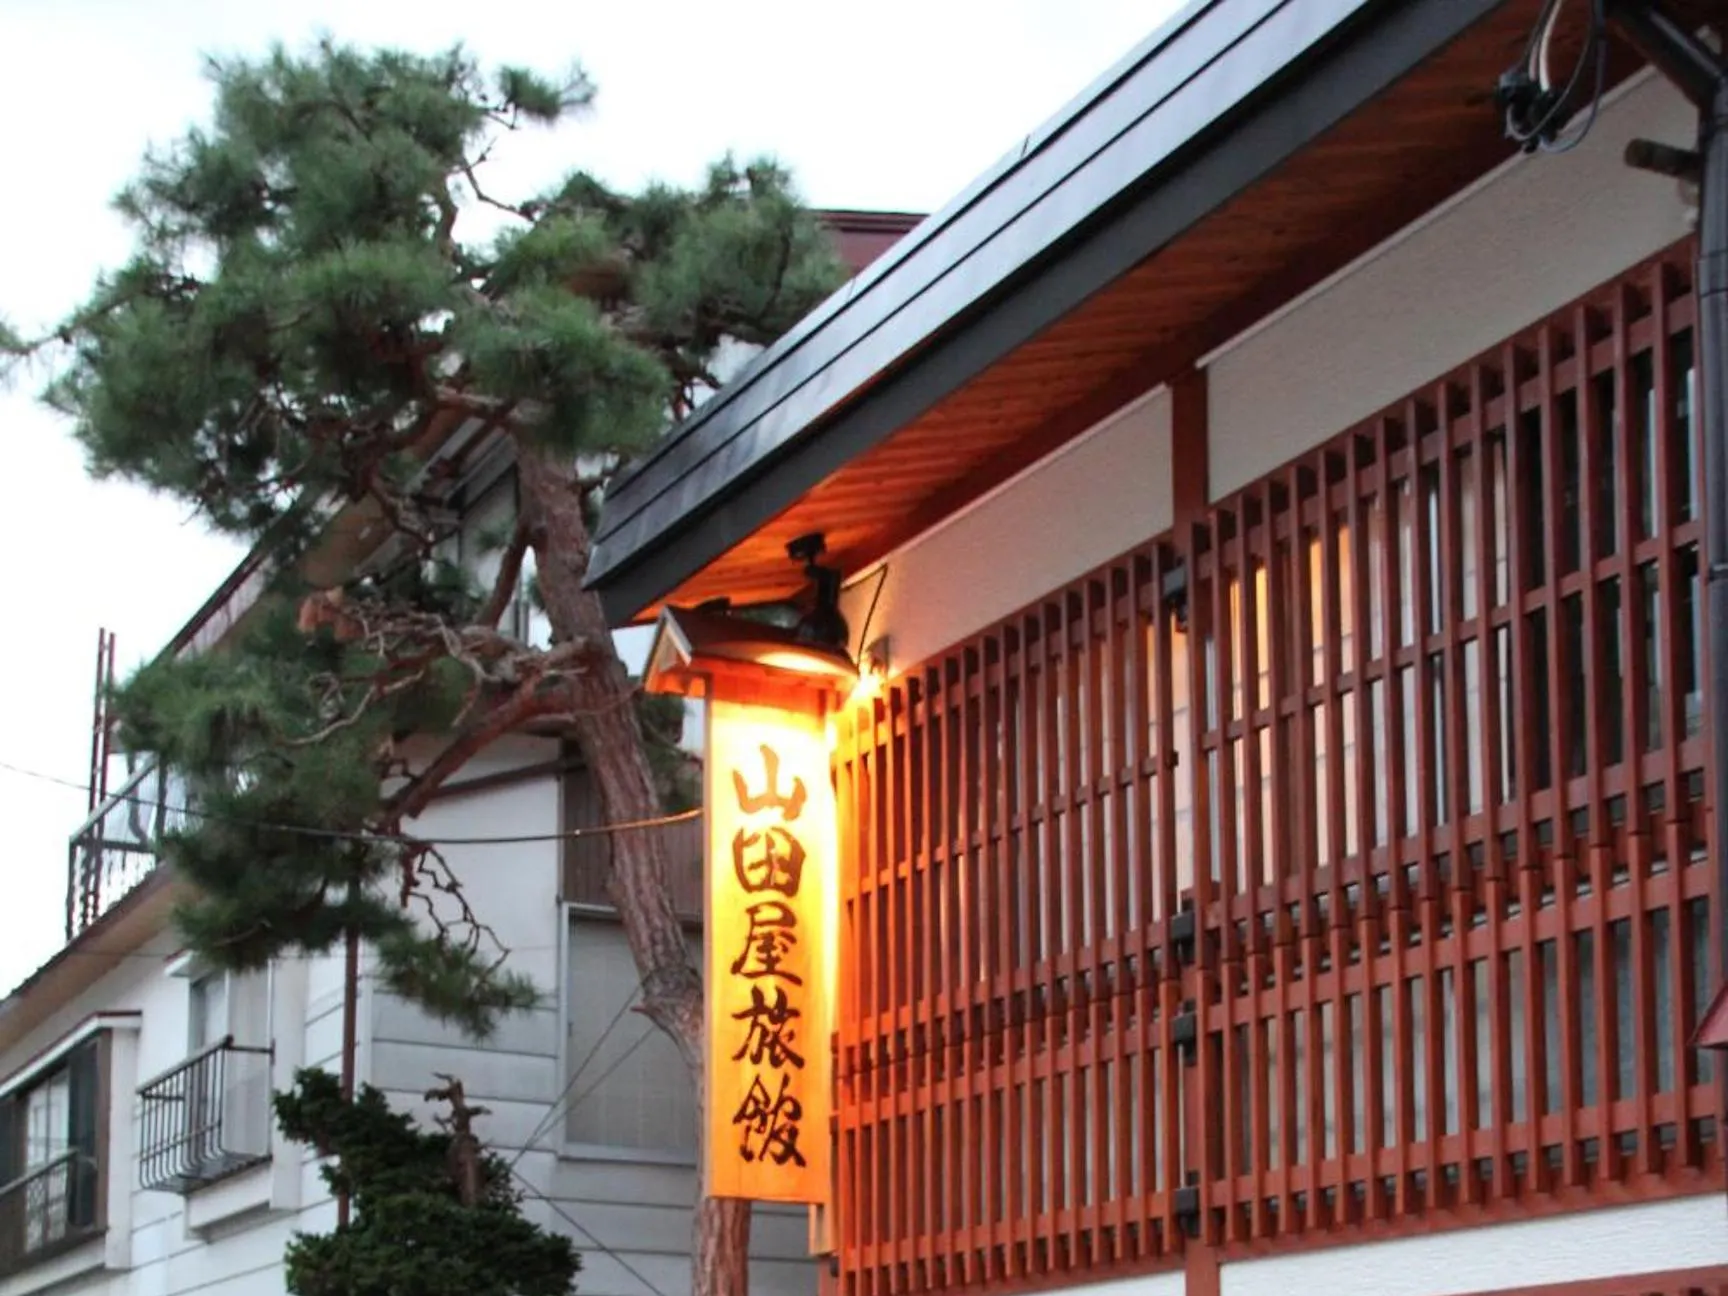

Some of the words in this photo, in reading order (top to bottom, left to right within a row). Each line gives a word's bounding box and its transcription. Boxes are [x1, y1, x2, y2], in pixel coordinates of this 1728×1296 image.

[731, 744, 807, 1168] 山田屋旅館
